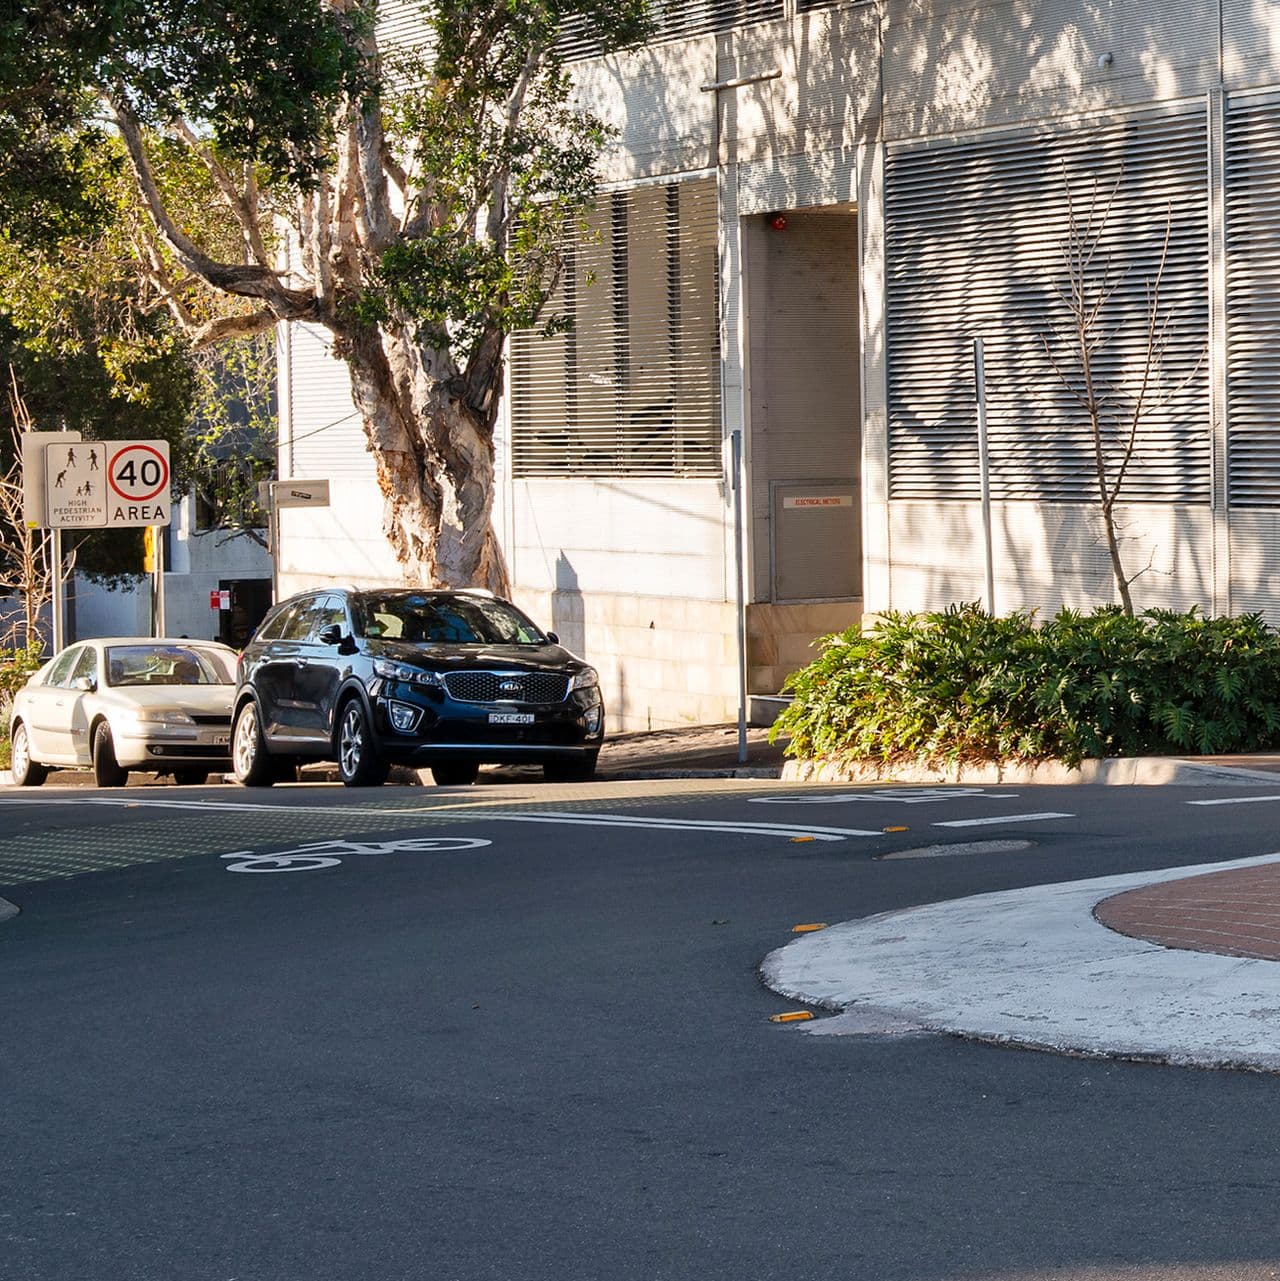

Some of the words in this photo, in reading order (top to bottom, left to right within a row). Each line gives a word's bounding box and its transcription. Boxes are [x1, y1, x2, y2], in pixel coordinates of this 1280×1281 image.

[116, 459, 161, 487] 40
[68, 499, 87, 507] HIGH
[795, 498, 821, 506] ELECTRICAL
[53, 506, 102, 515] PEDESTRIAN
[113, 505, 165, 521] AREA
[60, 514, 96, 522] ACTIVITY
[504, 683, 519, 691] KIA
